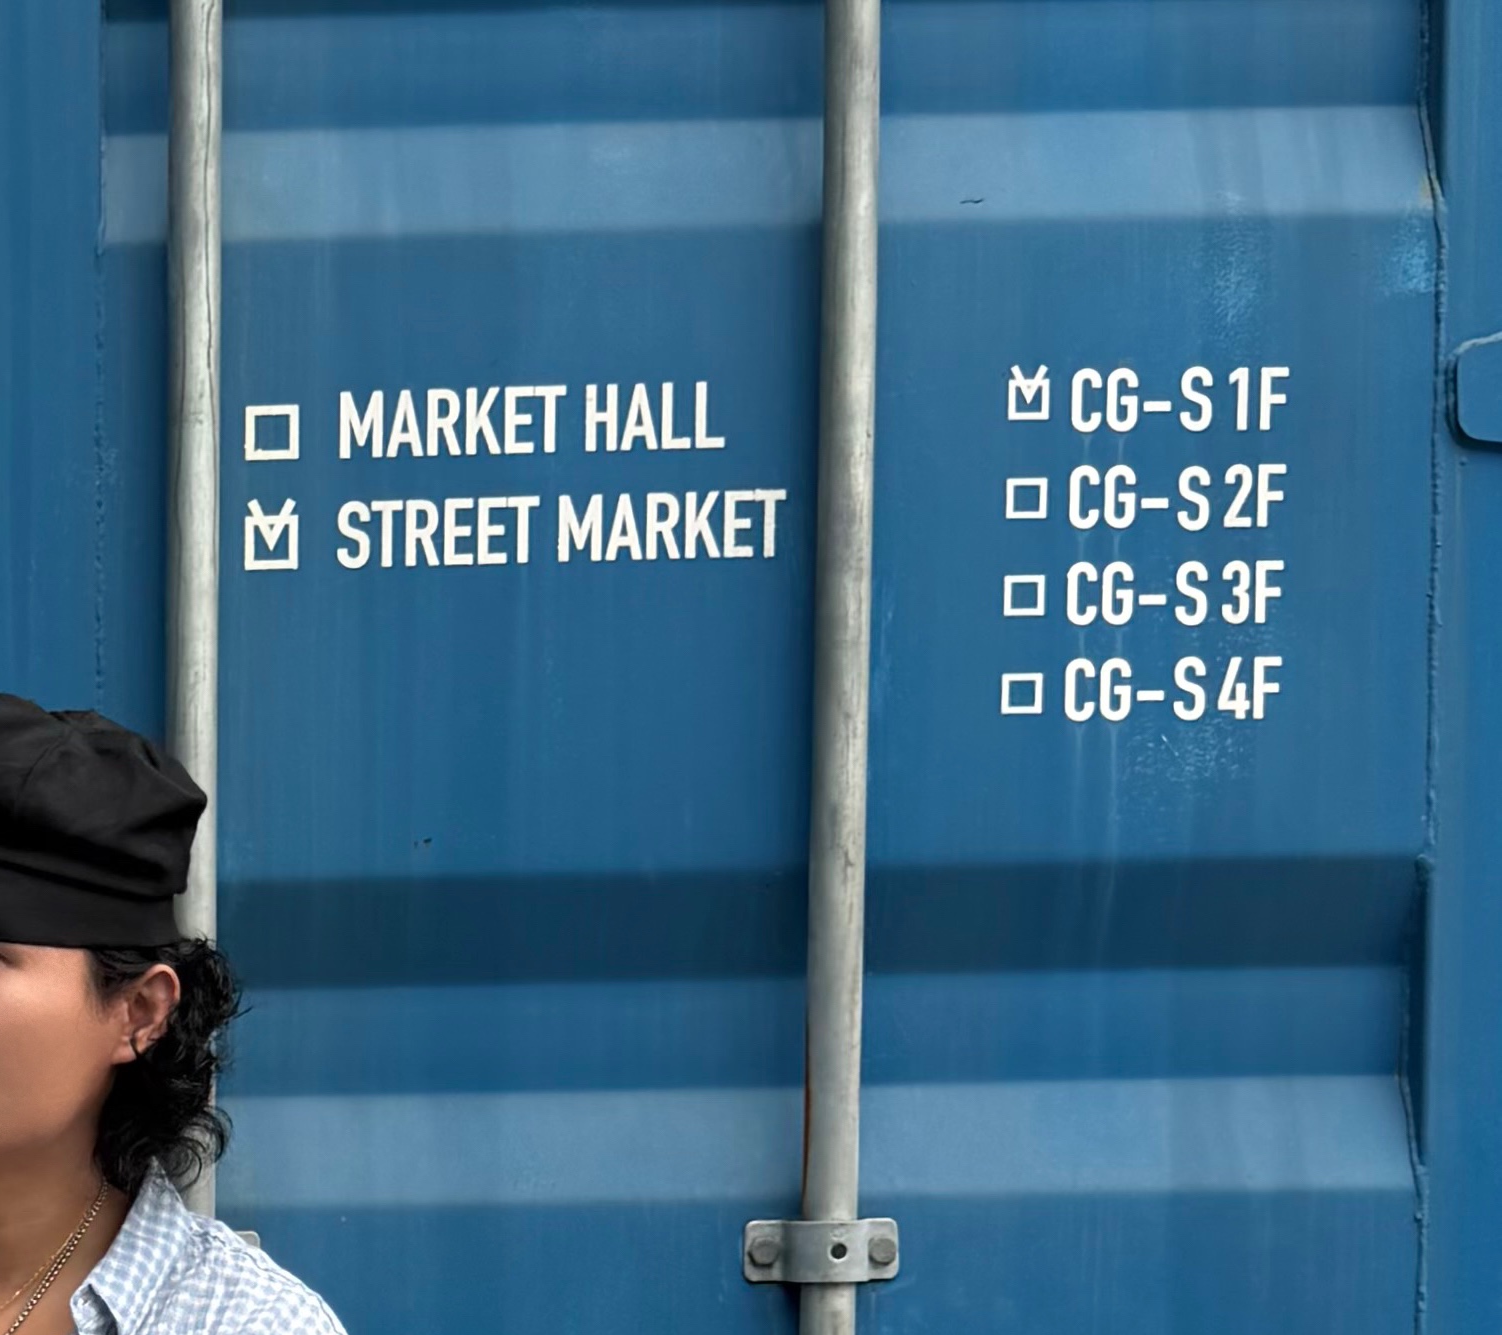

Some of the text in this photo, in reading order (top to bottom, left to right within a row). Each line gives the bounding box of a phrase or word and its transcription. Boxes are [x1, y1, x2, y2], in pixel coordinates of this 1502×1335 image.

[339, 380, 726, 459] MARKET HALL
[336, 488, 787, 569] STREET MARKET
